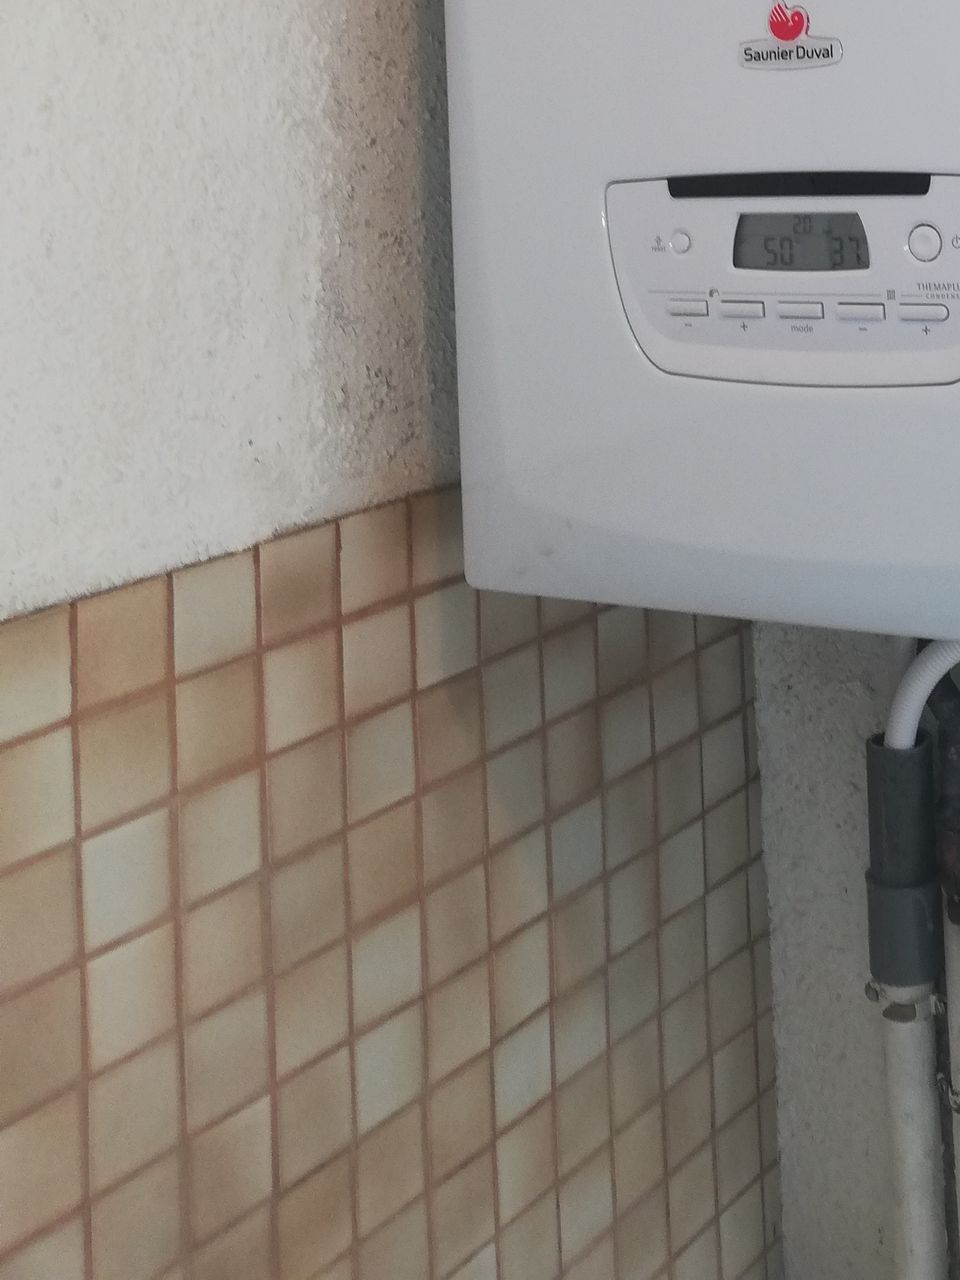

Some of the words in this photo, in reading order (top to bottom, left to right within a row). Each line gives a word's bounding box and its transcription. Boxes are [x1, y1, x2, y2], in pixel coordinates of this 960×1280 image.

[744, 47, 793, 62] Saunier
[796, 44, 833, 59] Duval
[791, 324, 813, 333] mode
